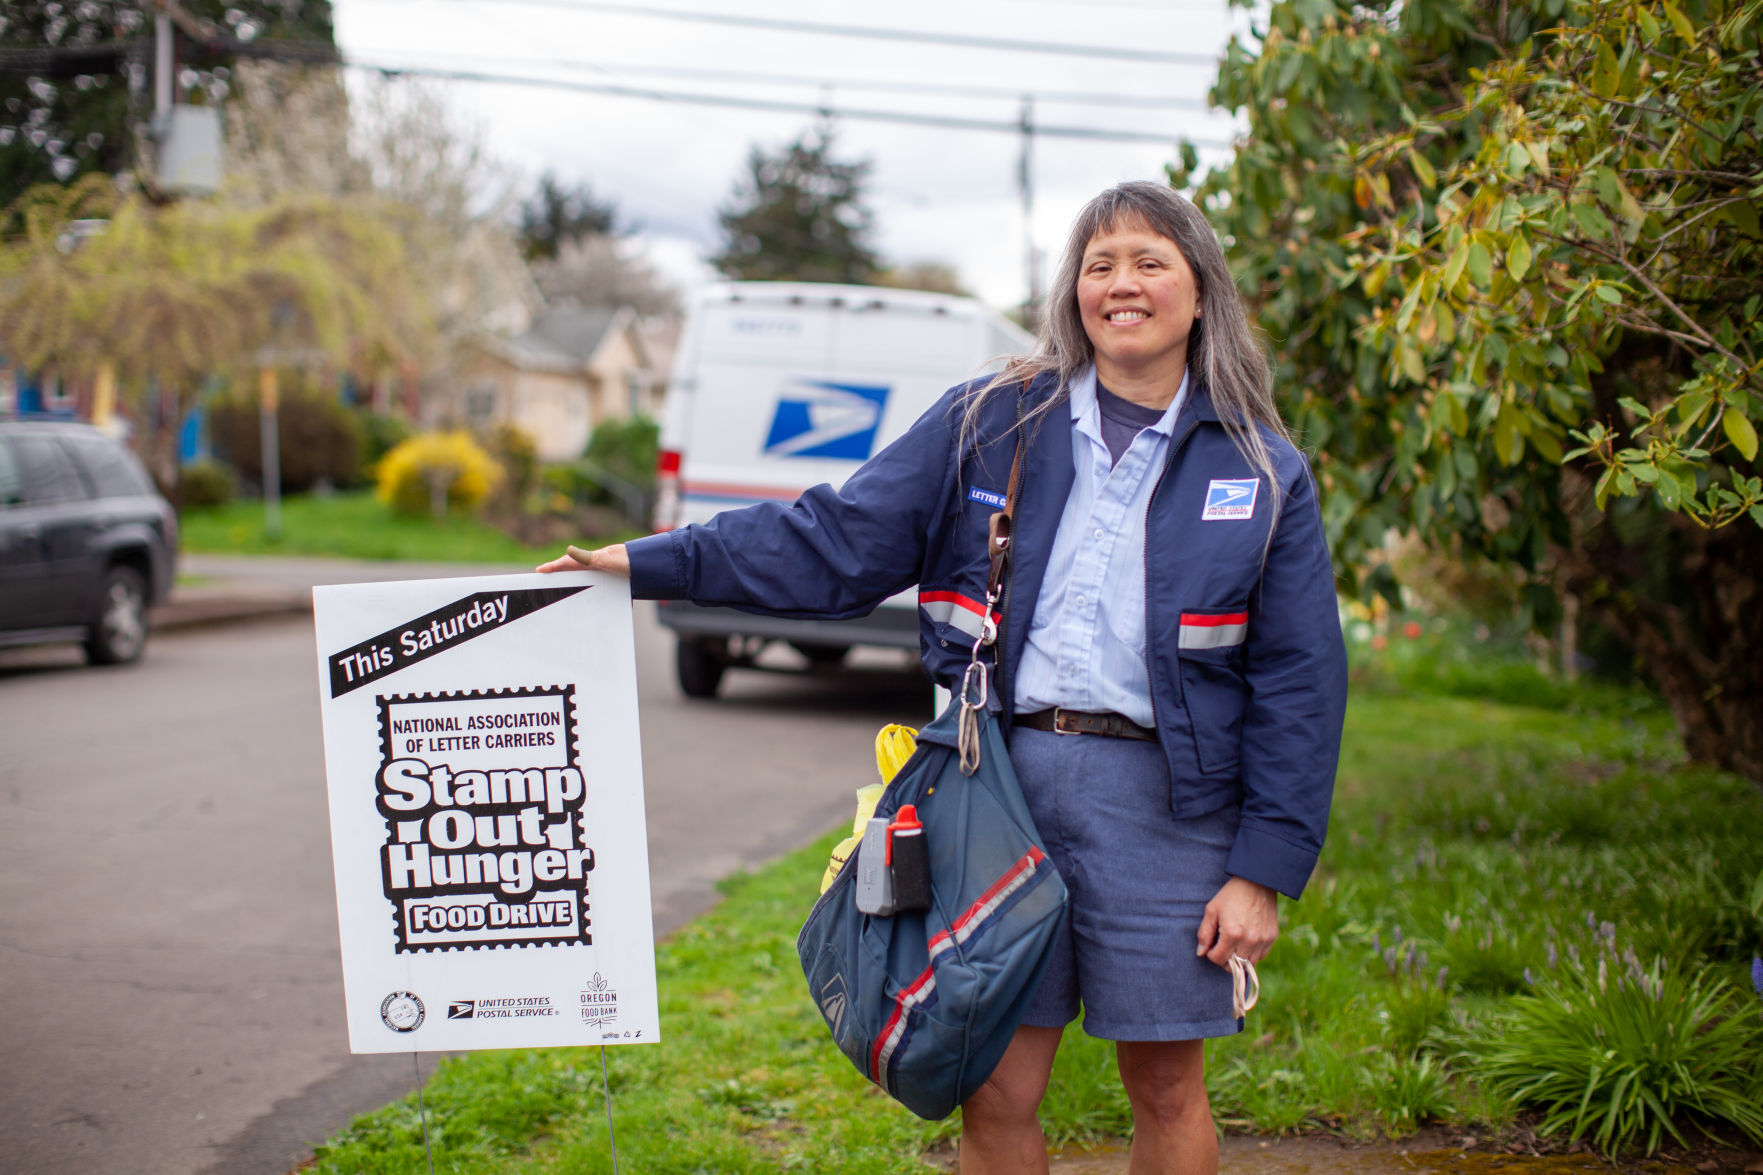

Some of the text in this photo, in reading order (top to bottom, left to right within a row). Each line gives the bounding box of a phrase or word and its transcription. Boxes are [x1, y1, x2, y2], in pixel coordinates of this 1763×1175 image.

[971, 490, 999, 504] LETTER
[338, 595, 509, 682] This Saturday
[393, 711, 561, 734] NATIONAL ASSOCIATION
[406, 731, 555, 753] OF LETTER CARRIERS
[380, 757, 585, 815] Stamp
[426, 805, 548, 850] Out
[386, 843, 592, 895] Hunger
[413, 901, 572, 930] FOOD DRIVE
[478, 997, 551, 1007] UNITED STATES
[580, 993, 617, 1003] OREGON
[477, 1008, 554, 1018] POSTAL SERVICE
[581, 1007, 617, 1018] FOOD BANK
